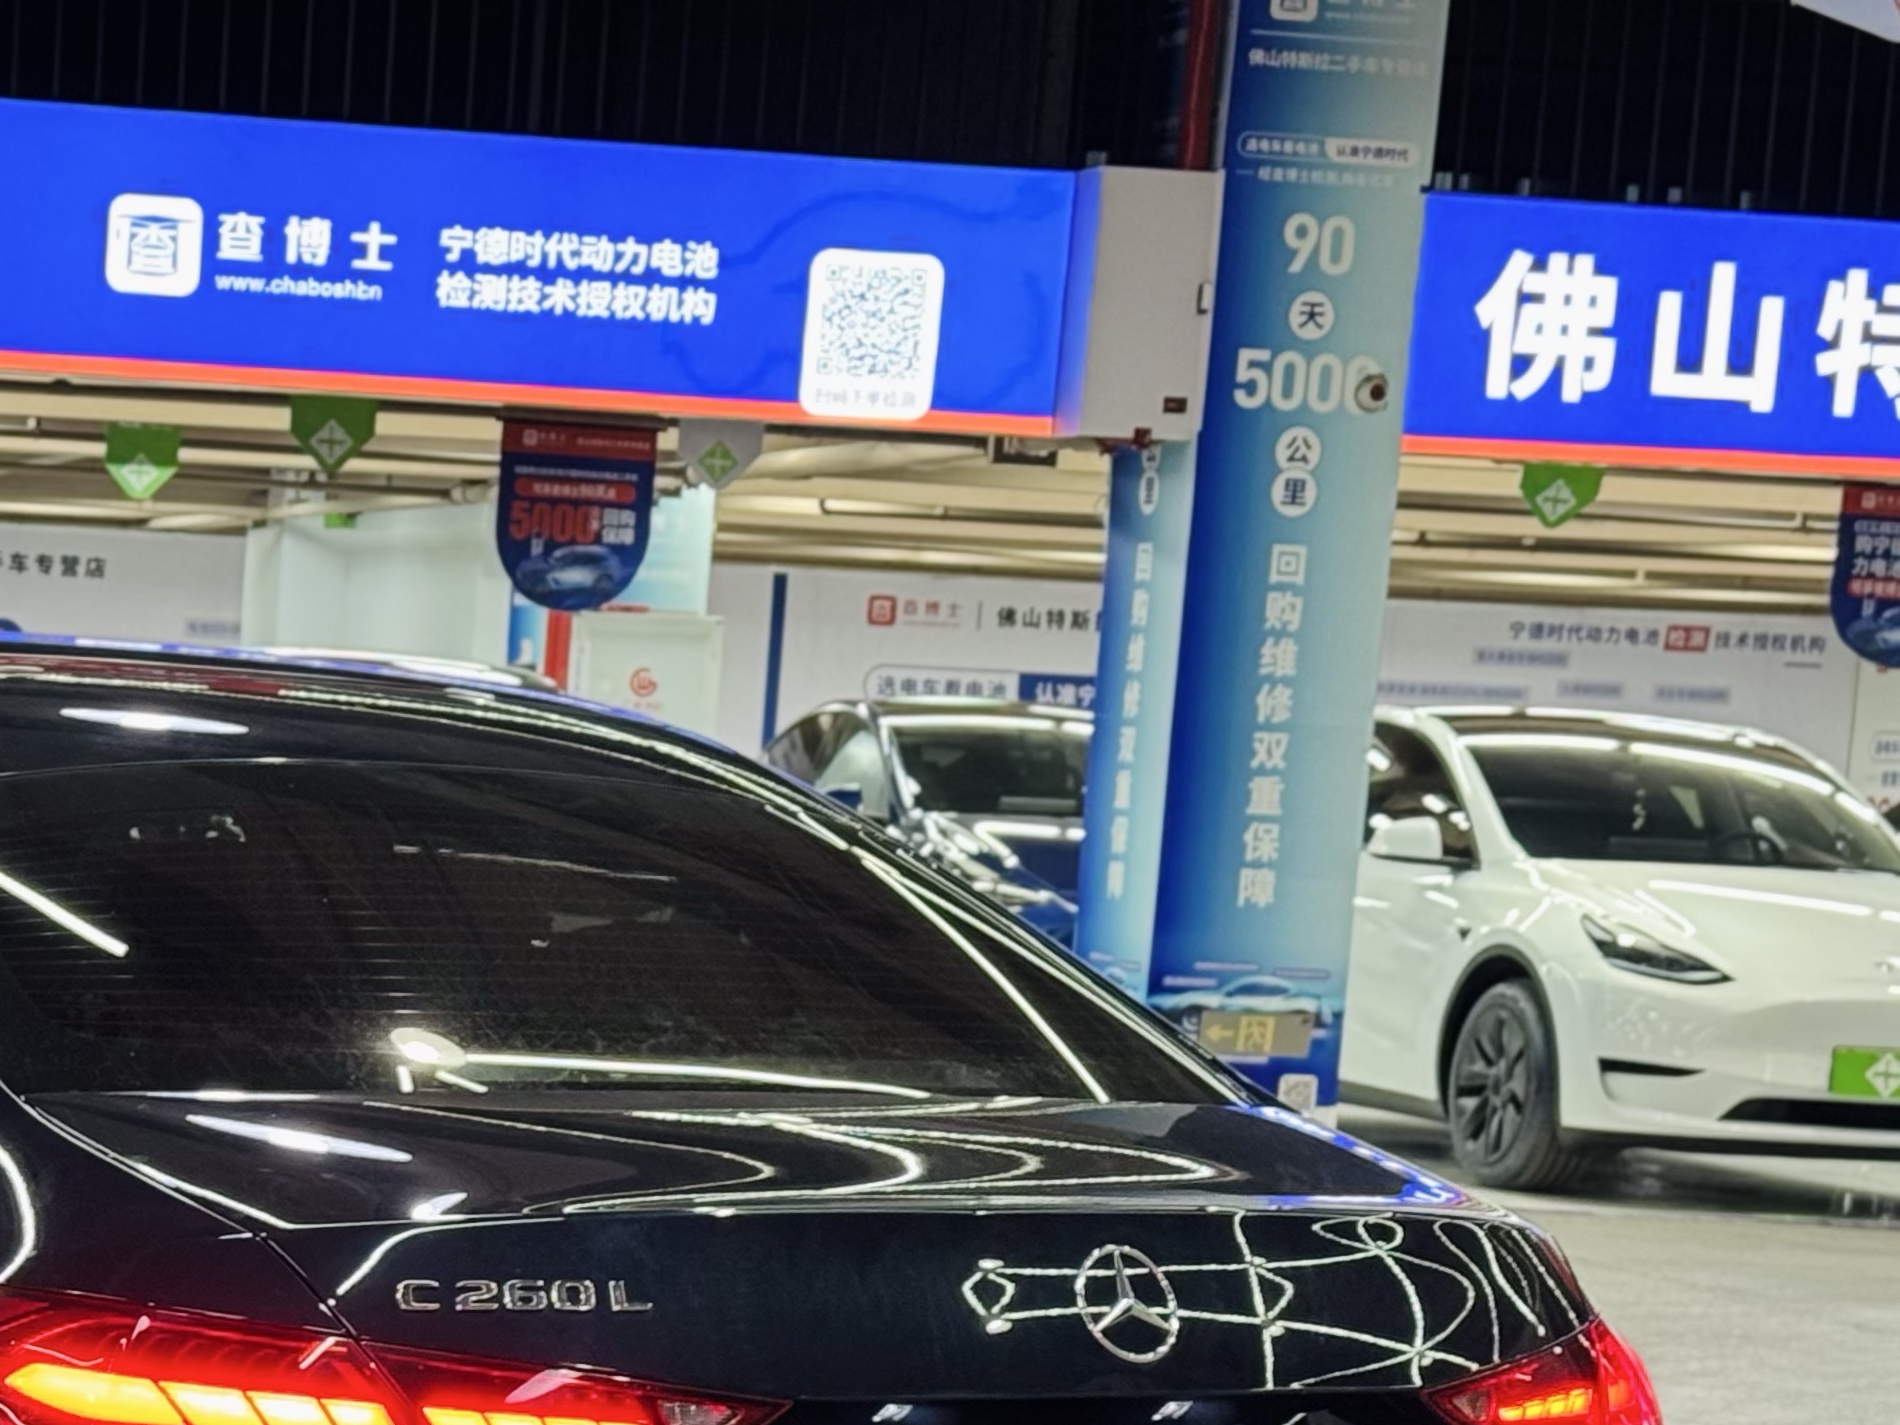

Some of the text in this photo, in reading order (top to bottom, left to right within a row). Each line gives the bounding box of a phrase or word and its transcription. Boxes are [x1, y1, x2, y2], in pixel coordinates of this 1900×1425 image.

[215, 211, 398, 272] 查博士
[438, 224, 720, 279] 宁德时代动力电池
[1283, 212, 1355, 276] 90
[435, 269, 718, 326] 检测技术授权机构
[1297, 301, 1325, 331] 天
[1509, 620, 1660, 648] 宁德时代动力电池
[1714, 632, 1827, 656] 技术授权机构
[1236, 542, 1308, 909] 回购维修双重保障
[395, 1278, 654, 1312] C 260 L
